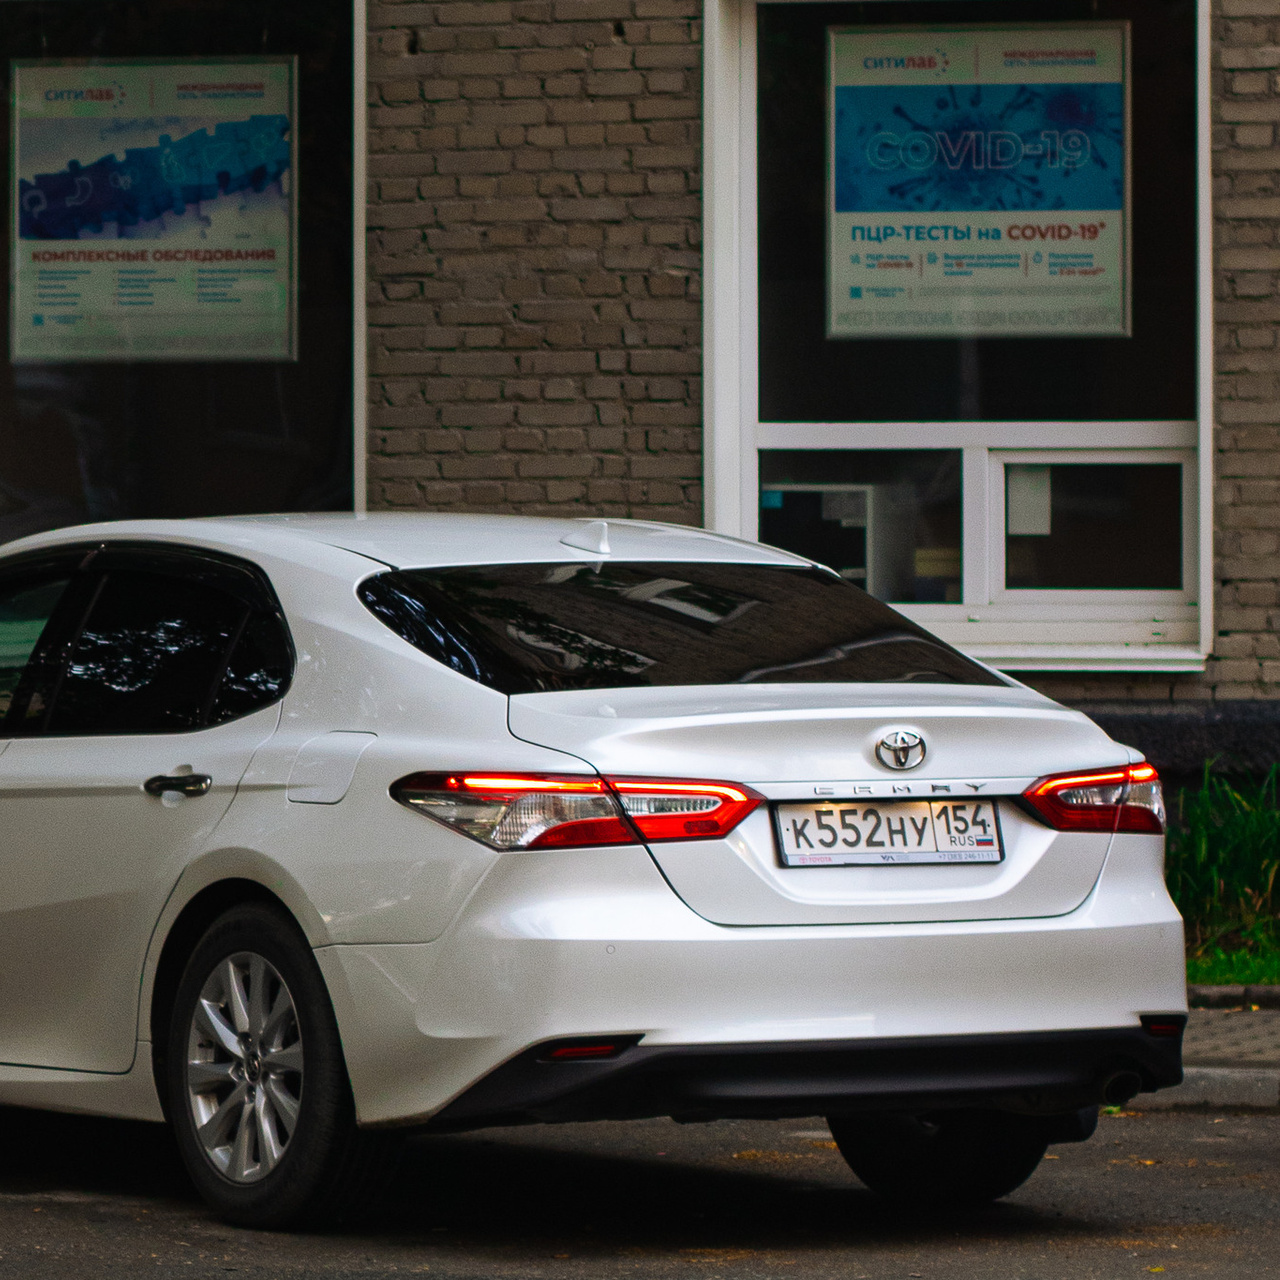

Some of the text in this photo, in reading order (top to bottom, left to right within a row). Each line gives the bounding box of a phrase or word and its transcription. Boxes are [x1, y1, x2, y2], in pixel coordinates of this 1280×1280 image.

[867, 129, 1092, 171] COVID-19
[850, 224, 972, 243] ПЦР-ТЕСТЫ
[977, 226, 1002, 241] на
[31, 248, 276, 263] КОМПЛЕКСНЫЕ ОБСЛЕДОВАНИЯ
[813, 782, 988, 796] CAMRY
[935, 804, 988, 835] 154
[949, 835, 976, 847] RUS
[808, 855, 833, 864] TOYOTA
